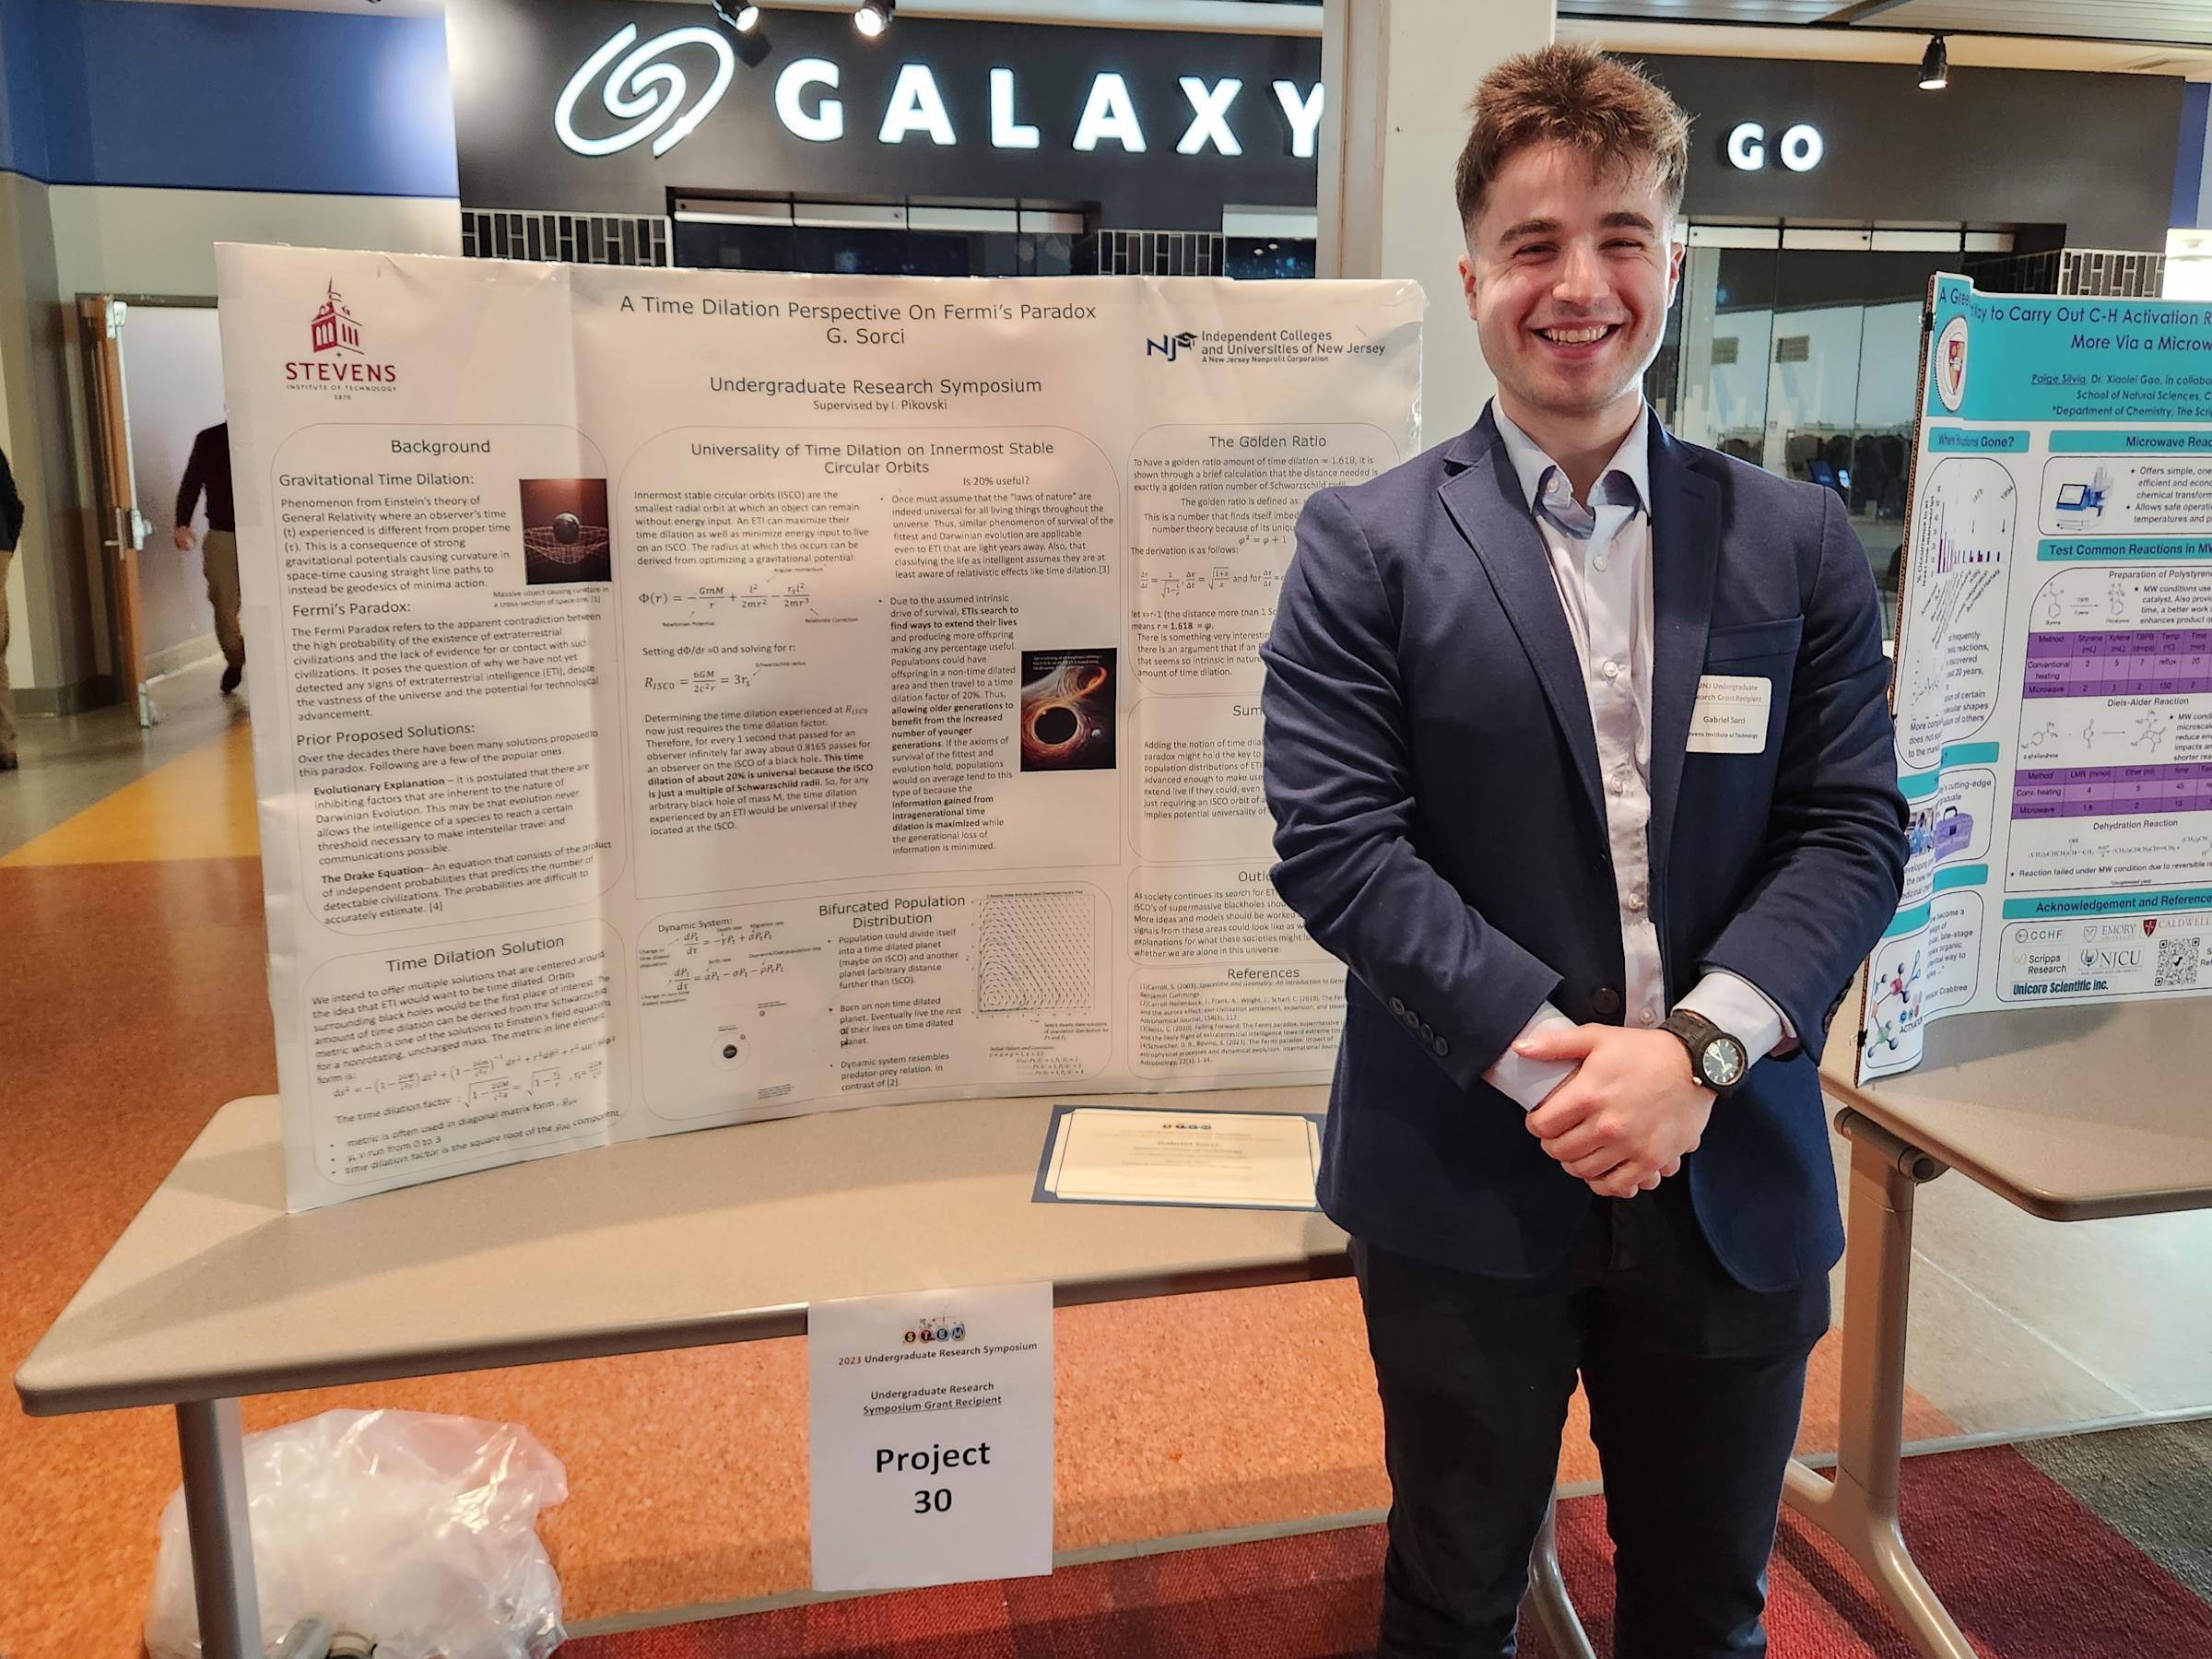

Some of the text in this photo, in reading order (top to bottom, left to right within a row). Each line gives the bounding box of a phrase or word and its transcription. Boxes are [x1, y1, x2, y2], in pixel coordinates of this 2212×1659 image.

[774, 58, 1324, 158] GALAXY
[1727, 122, 1823, 172] GO
[619, 295, 1096, 324] A Time Dilation Perspective On Fermi's Paradox
[1937, 287, 1947, 303] A
[1990, 306, 2005, 321] to
[2008, 307, 2052, 324] Carry
[2056, 308, 2085, 323] Out
[2088, 308, 2118, 323] C-H
[2122, 309, 2198, 324] Activation
[826, 327, 904, 345] G. Sorci
[1202, 330, 1332, 344] Independent Colleges
[2071, 334, 2111, 349] More
[2116, 335, 2139, 350] Via
[2143, 339, 2153, 350] a
[1201, 344, 1385, 356] and Universities of New Jersey
[285, 362, 395, 382] STEVENS
[710, 376, 1041, 396] Undergraduate Research Symposium
[813, 400, 873, 412] Supervised
[876, 400, 888, 412] by
[901, 398, 947, 410] Pikovski
[391, 439, 490, 456] Background
[1207, 434, 1327, 448] The Golden Ratio
[1980, 435, 2015, 448] Gone?
[2125, 436, 2184, 448] Microwave
[691, 441, 1053, 459] Universality of Time Dilation on Innermost Stable
[824, 460, 929, 474] Circular Orbits
[278, 472, 474, 487] Gravitational Time Dilation:
[962, 476, 1030, 487] Is 20% useful?
[280, 495, 480, 509] Phenomenon from Einstein's theory of
[2049, 543, 2195, 556] Test Common Reactions in
[292, 600, 411, 617] Fermi's Paradox:
[2107, 697, 2189, 707] Diels-Alder Reaction
[296, 724, 475, 746] Prior Proposed Solutions:
[2092, 818, 2178, 831] Dehydration Reaction
[818, 895, 965, 916] Bifurcated Population
[2035, 898, 2136, 912] Acknowledgement
[2138, 895, 2159, 908] and
[853, 913, 932, 929] Distribution
[2030, 929, 2063, 940] CCHF
[384, 937, 564, 972] Time Dilation Solution
[2028, 954, 2061, 965] Scripps
[2100, 950, 2140, 968] NJCU
[1227, 968, 1300, 980] References
[2028, 963, 2066, 974] Research
[2013, 979, 2109, 995] Unicore Scientific Inc.
[838, 1342, 1038, 1366] 2023 Undergraduate Research Symposium
[870, 1382, 994, 1400] Undergraduate Research
[863, 1395, 1001, 1417] Symposium Grant Recipient
[877, 1442, 991, 1476] Project
[914, 1488, 952, 1513] 30
